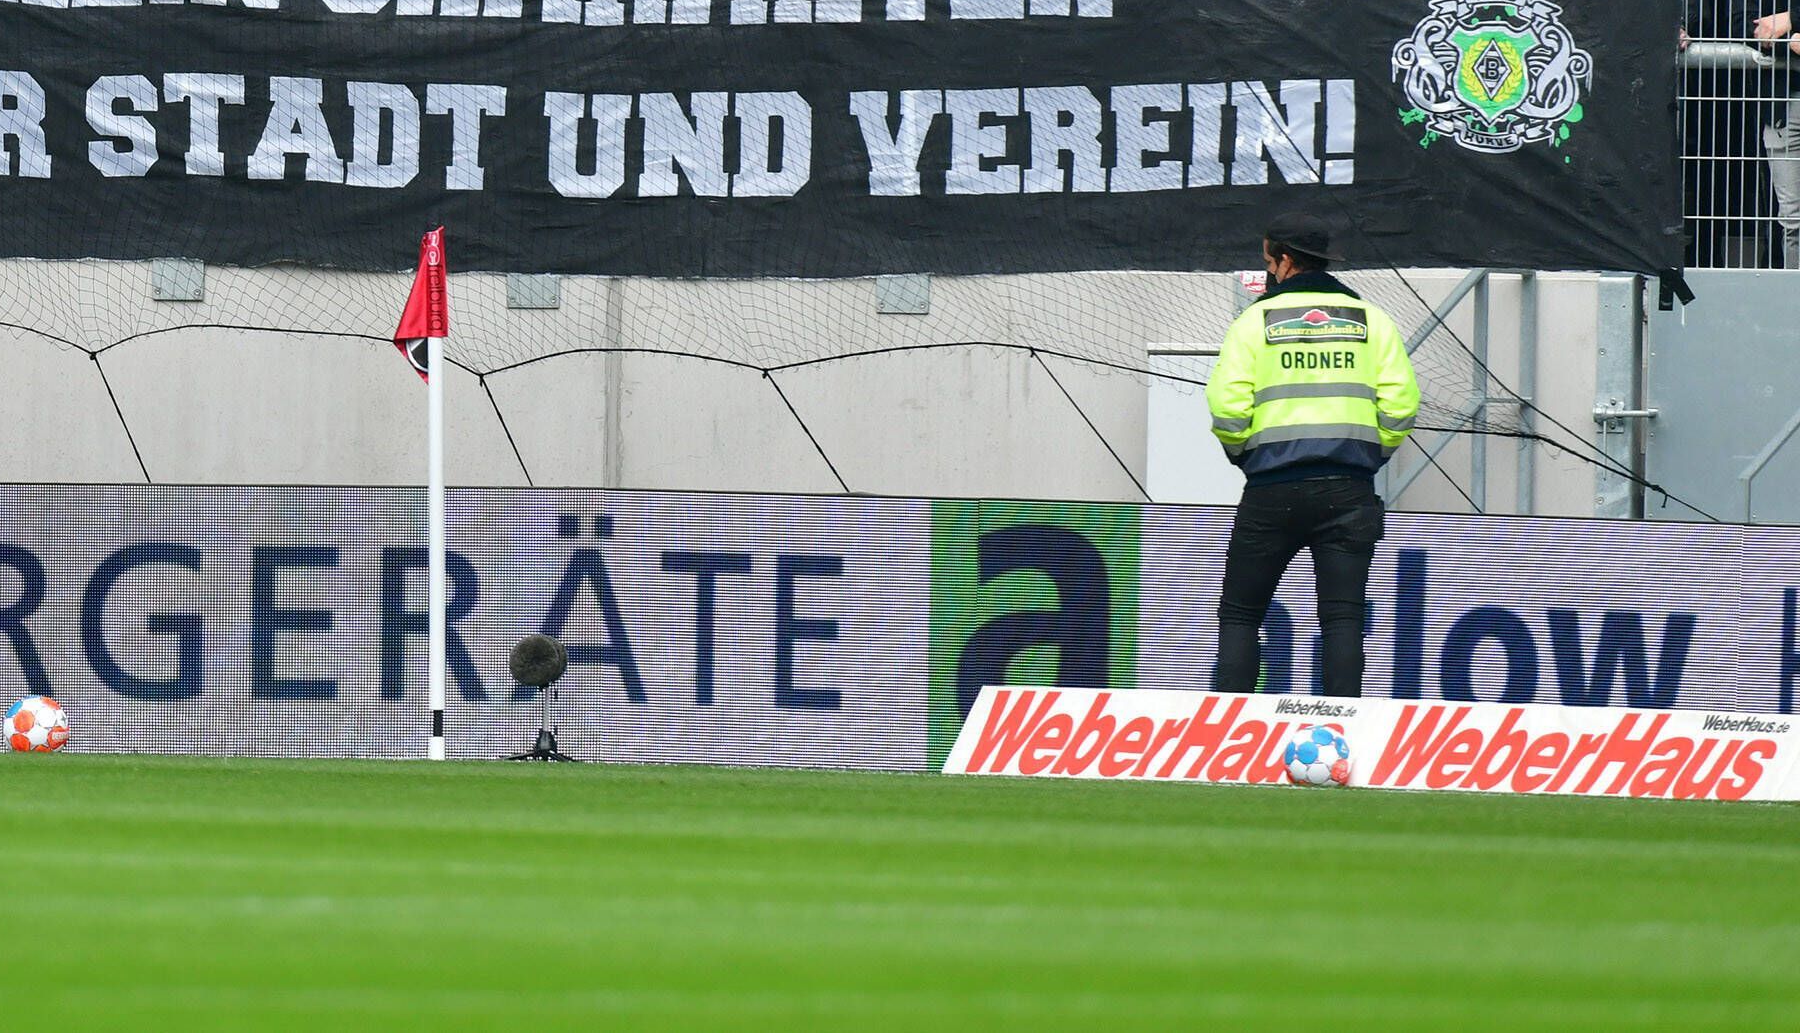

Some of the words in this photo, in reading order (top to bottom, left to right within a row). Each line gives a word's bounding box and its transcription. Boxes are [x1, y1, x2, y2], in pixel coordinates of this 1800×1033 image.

[85, 72, 508, 191] STADT
[543, 90, 813, 199] UND
[849, 78, 1357, 197] VEREIN!
[1281, 351, 1356, 370] ORDNER
[1274, 698, 1358, 717] WeberHaus.de
[1702, 714, 1792, 734] WeberHaus.de
[964, 688, 1346, 787] WeberHau
[1368, 704, 1779, 800] WeberHaus
